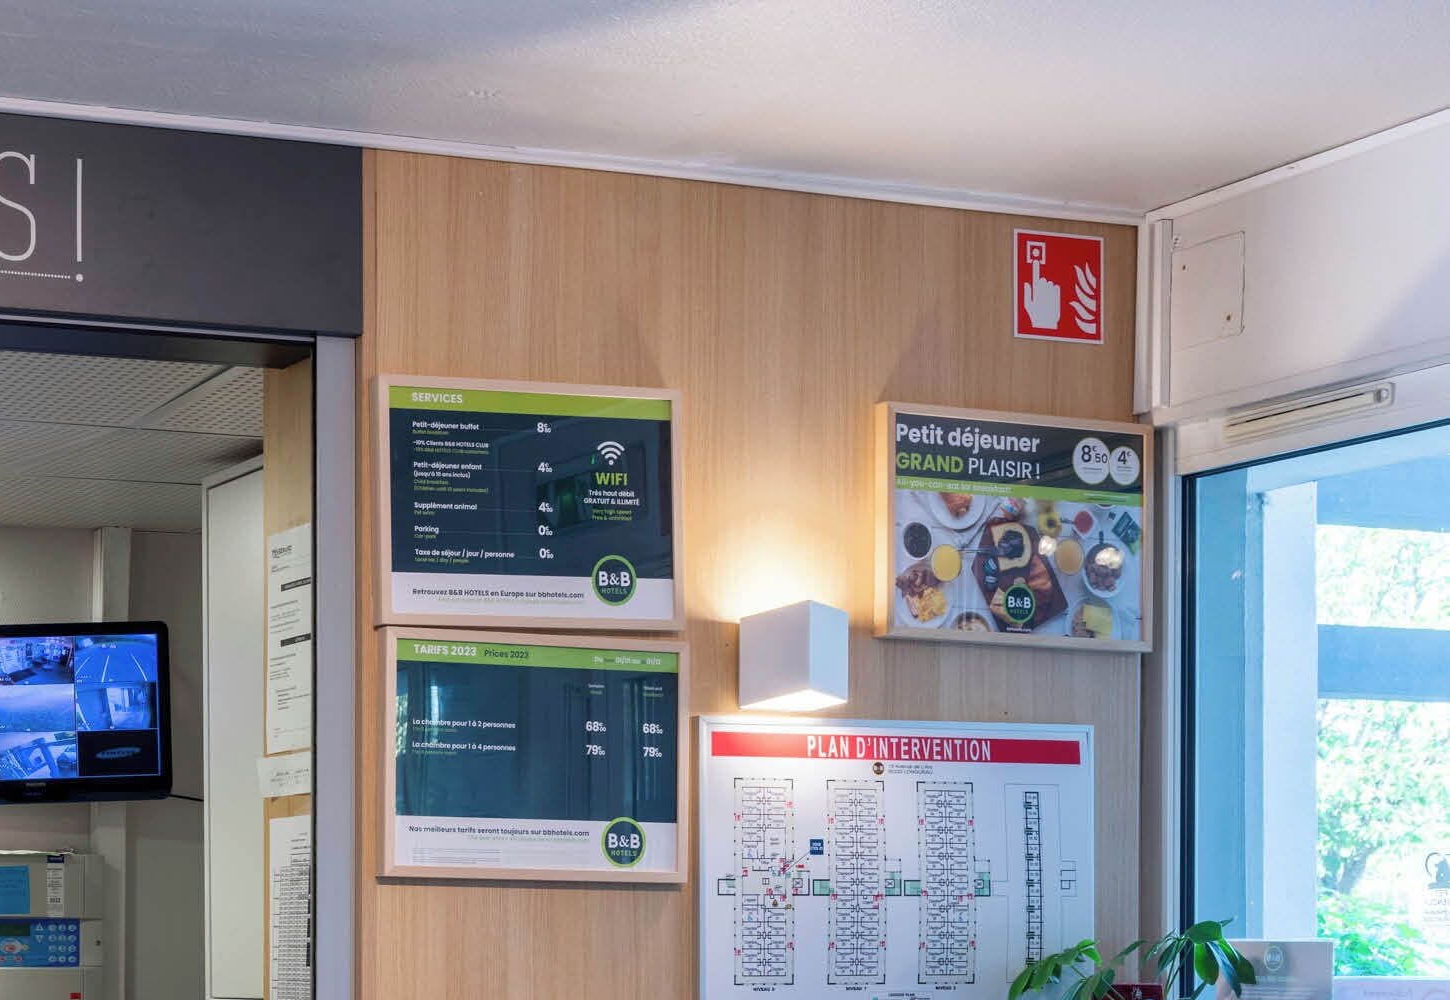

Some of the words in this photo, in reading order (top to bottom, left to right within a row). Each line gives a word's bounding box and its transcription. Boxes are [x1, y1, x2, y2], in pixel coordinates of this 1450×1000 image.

[411, 392, 463, 404] SERVICES
[412, 421, 459, 431] Petit-déjeuner
[460, 422, 479, 430] buffet
[895, 423, 943, 444] Petit
[947, 427, 1040, 453] déjeuner
[413, 461, 460, 471] Petit-déjeuner
[896, 452, 964, 474] GRAND
[968, 457, 1032, 479] PLAISIR
[595, 472, 628, 486] WIFI
[414, 502, 453, 510] Supplément
[414, 525, 439, 534] Parking
[414, 548, 430, 556] Taxe
[441, 549, 461, 558] séjour
[466, 550, 480, 558] jour
[484, 551, 515, 559] personne
[598, 570, 631, 587] B&B
[464, 589, 490, 597] HOTELS
[500, 590, 525, 598] Europe
[537, 591, 584, 599] bbhotels.com
[1008, 596, 1031, 609] B&B
[413, 644, 449, 656] TARIFS
[451, 646, 477, 656] 2023
[484, 649, 509, 658] Prices
[482, 721, 516, 729] personnes
[483, 744, 516, 752] personnes
[807, 735, 849, 759] PLAN
[856, 737, 991, 762] D'INTERVENTION
[423, 825, 456, 833] meilleurs
[457, 826, 476, 834] tarifs
[500, 827, 529, 836] toujours
[542, 829, 590, 837] bbhotels.com
[607, 833, 641, 849] B&B
